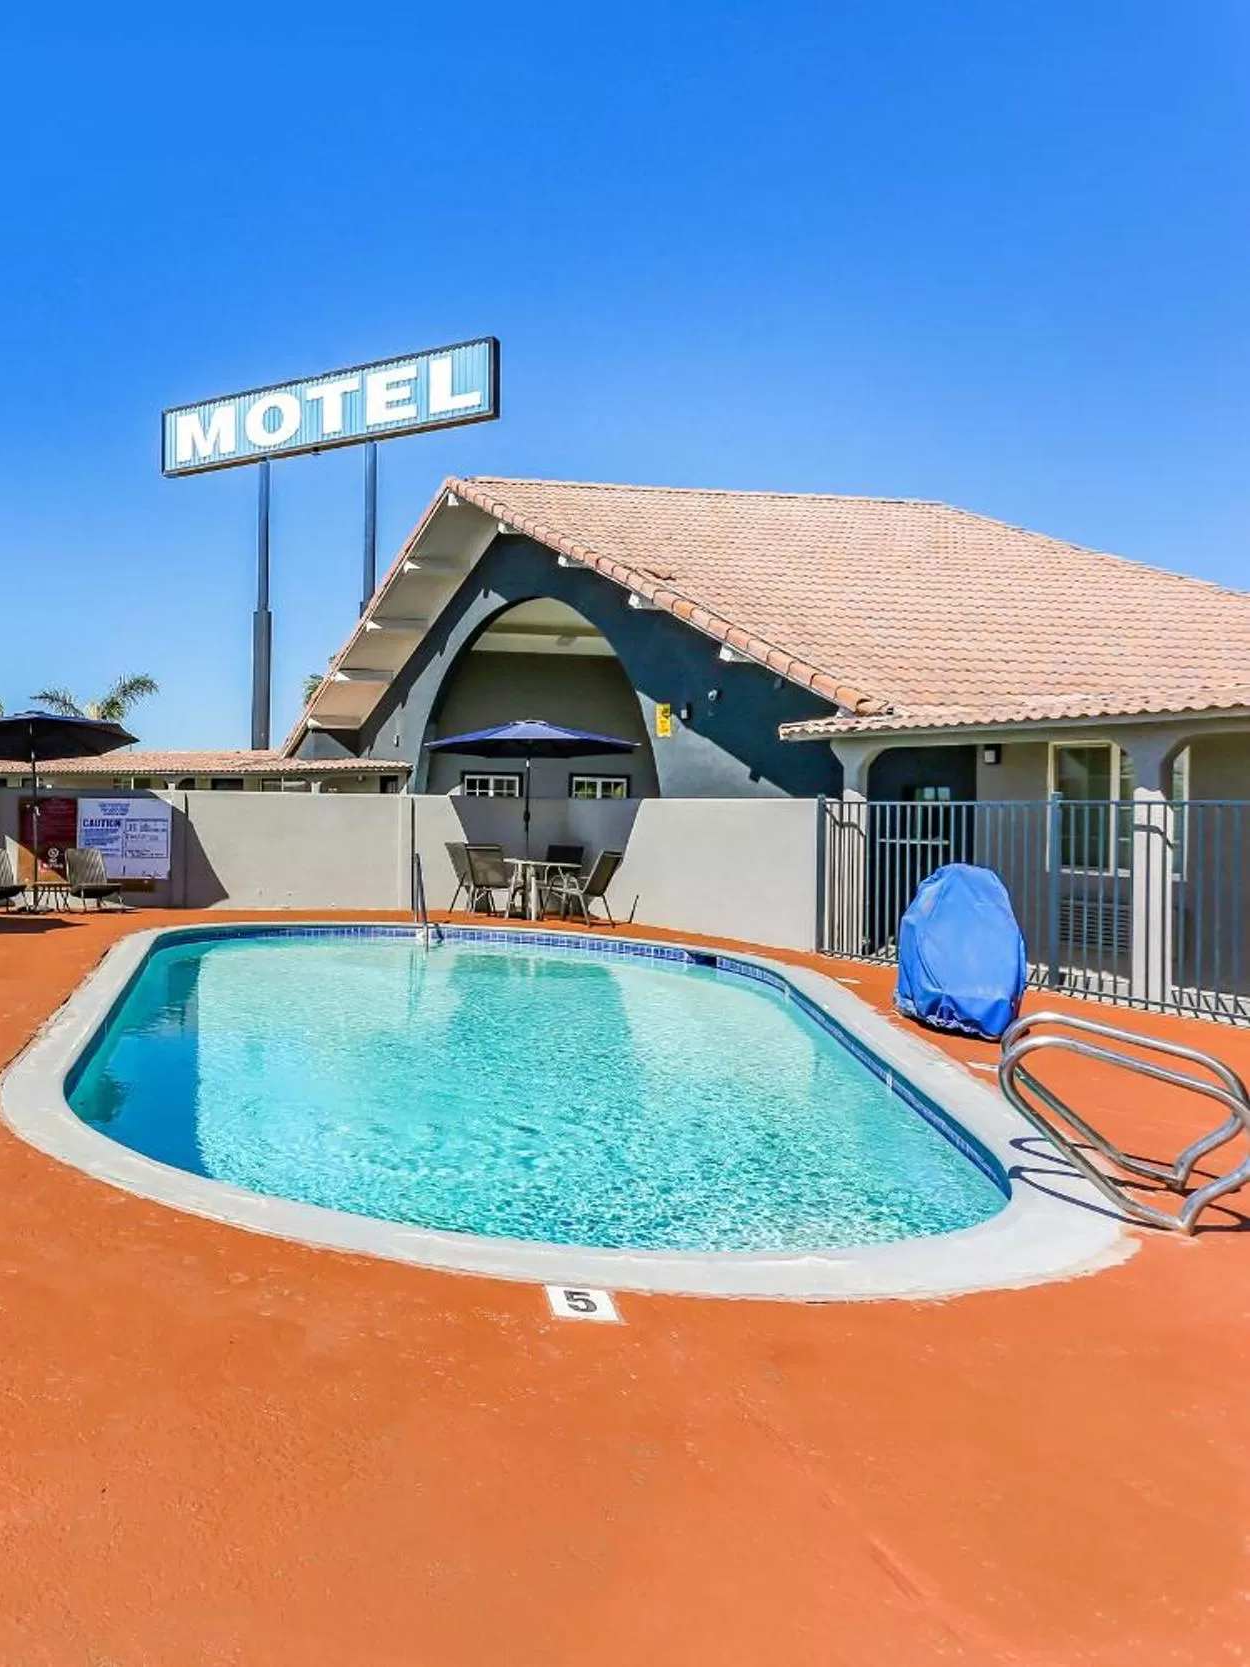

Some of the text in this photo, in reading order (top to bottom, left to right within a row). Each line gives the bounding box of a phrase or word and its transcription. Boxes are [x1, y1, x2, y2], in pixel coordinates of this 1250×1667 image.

[177, 356, 481, 462] MOTEL
[82, 819, 121, 827] CAUTION
[563, 1290, 597, 1312] 5
